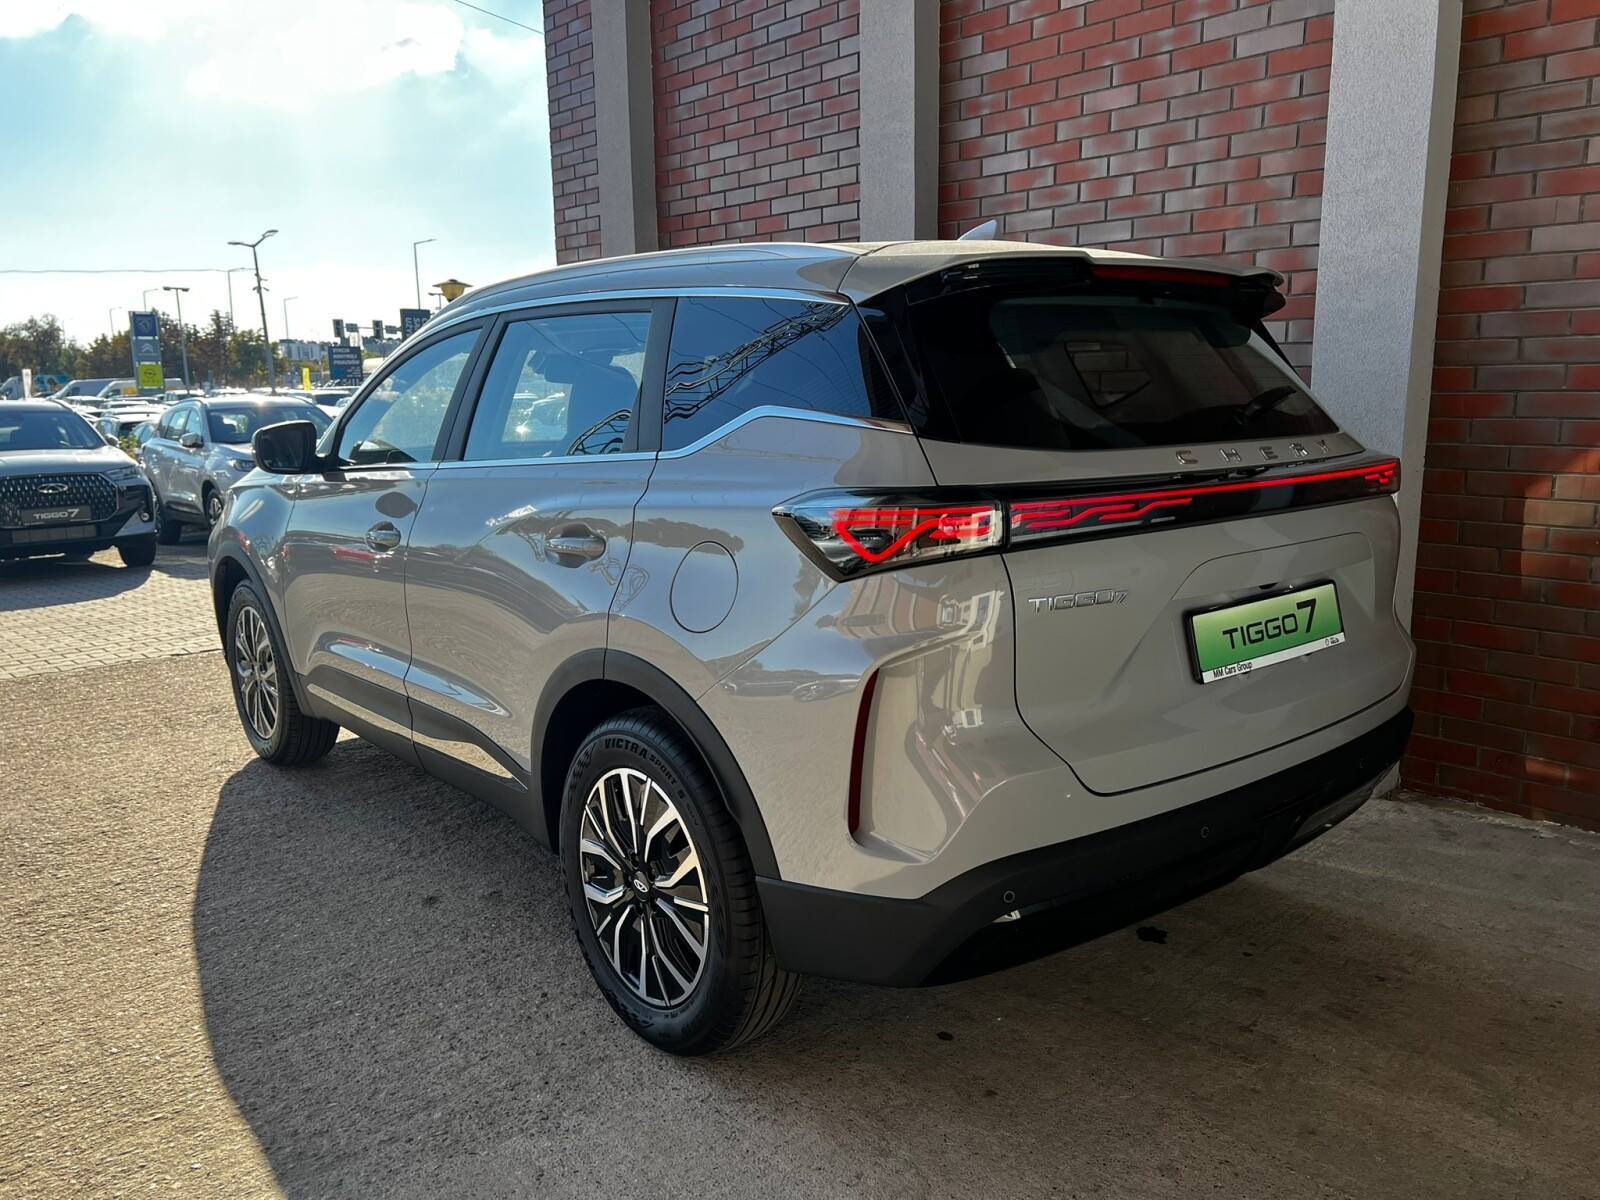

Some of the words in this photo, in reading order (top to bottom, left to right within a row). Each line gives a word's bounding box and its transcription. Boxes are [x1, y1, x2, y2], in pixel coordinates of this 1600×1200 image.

[1175, 439, 1329, 465] CHERY
[1213, 667, 1224, 678] MM
[1224, 665, 1236, 675] Cars
[1236, 661, 1252, 671] Group
[604, 738, 649, 760] VICTRA
[649, 754, 677, 785] SPORT
